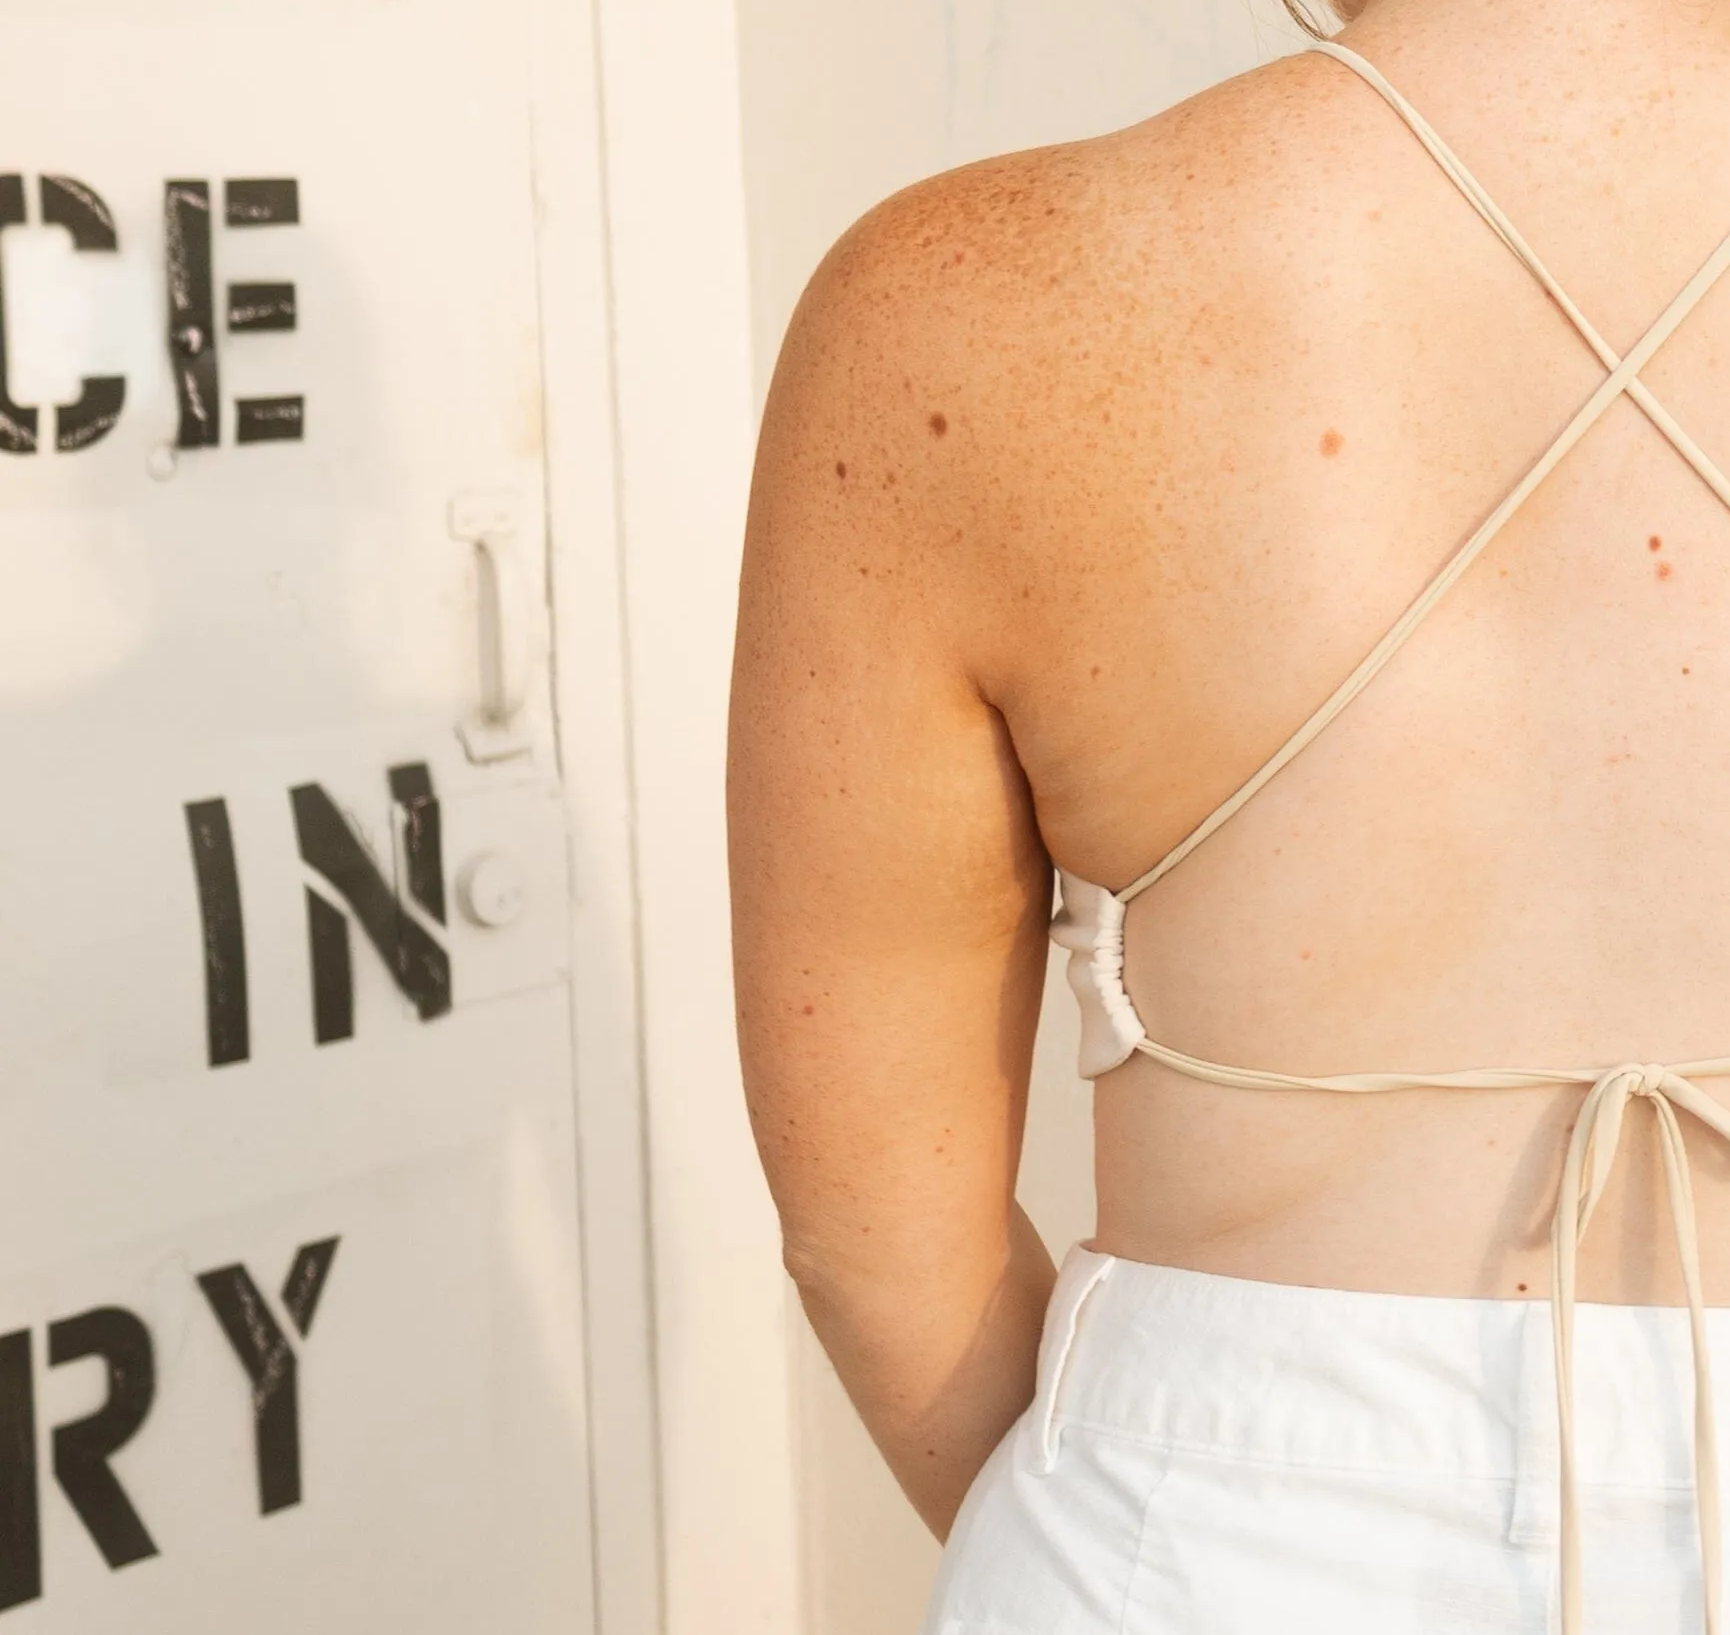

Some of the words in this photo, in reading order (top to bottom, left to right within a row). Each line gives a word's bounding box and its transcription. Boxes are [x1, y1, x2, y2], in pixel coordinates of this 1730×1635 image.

[0, 173, 304, 455] CE
[185, 762, 452, 1068] IN
[0, 1234, 341, 1614] RY
